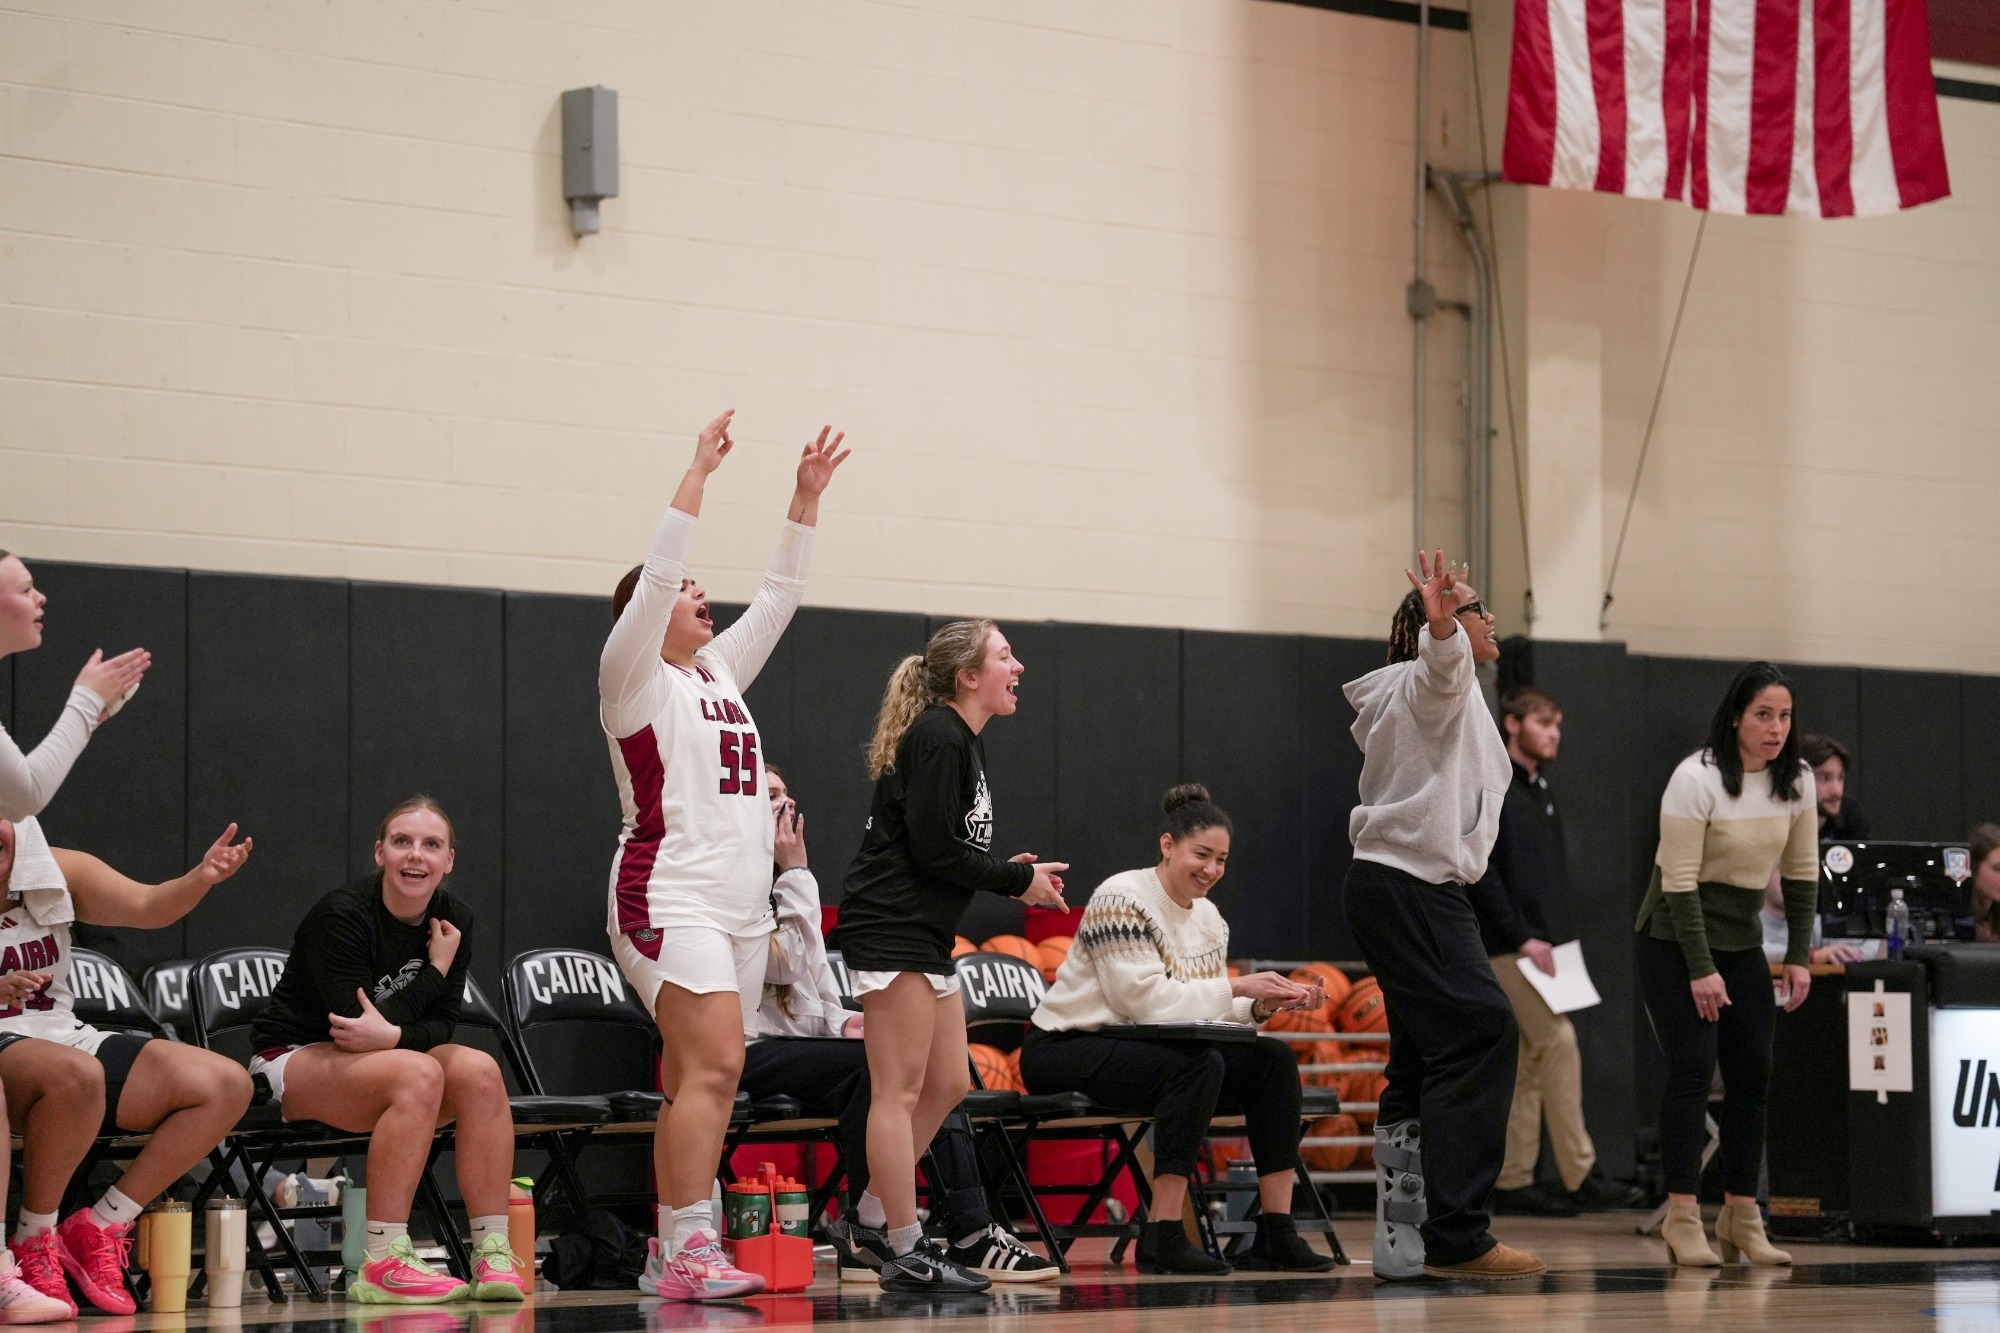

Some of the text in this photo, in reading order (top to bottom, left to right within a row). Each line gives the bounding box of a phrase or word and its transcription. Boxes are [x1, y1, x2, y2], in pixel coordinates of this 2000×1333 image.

[719, 730, 757, 796] 55
[0, 933, 60, 976] AIRN
[69, 959, 130, 1011] IRN
[209, 957, 285, 1010] CAIR
[522, 956, 626, 1005] CAIRN
[959, 962, 1047, 1008] CAIRN
